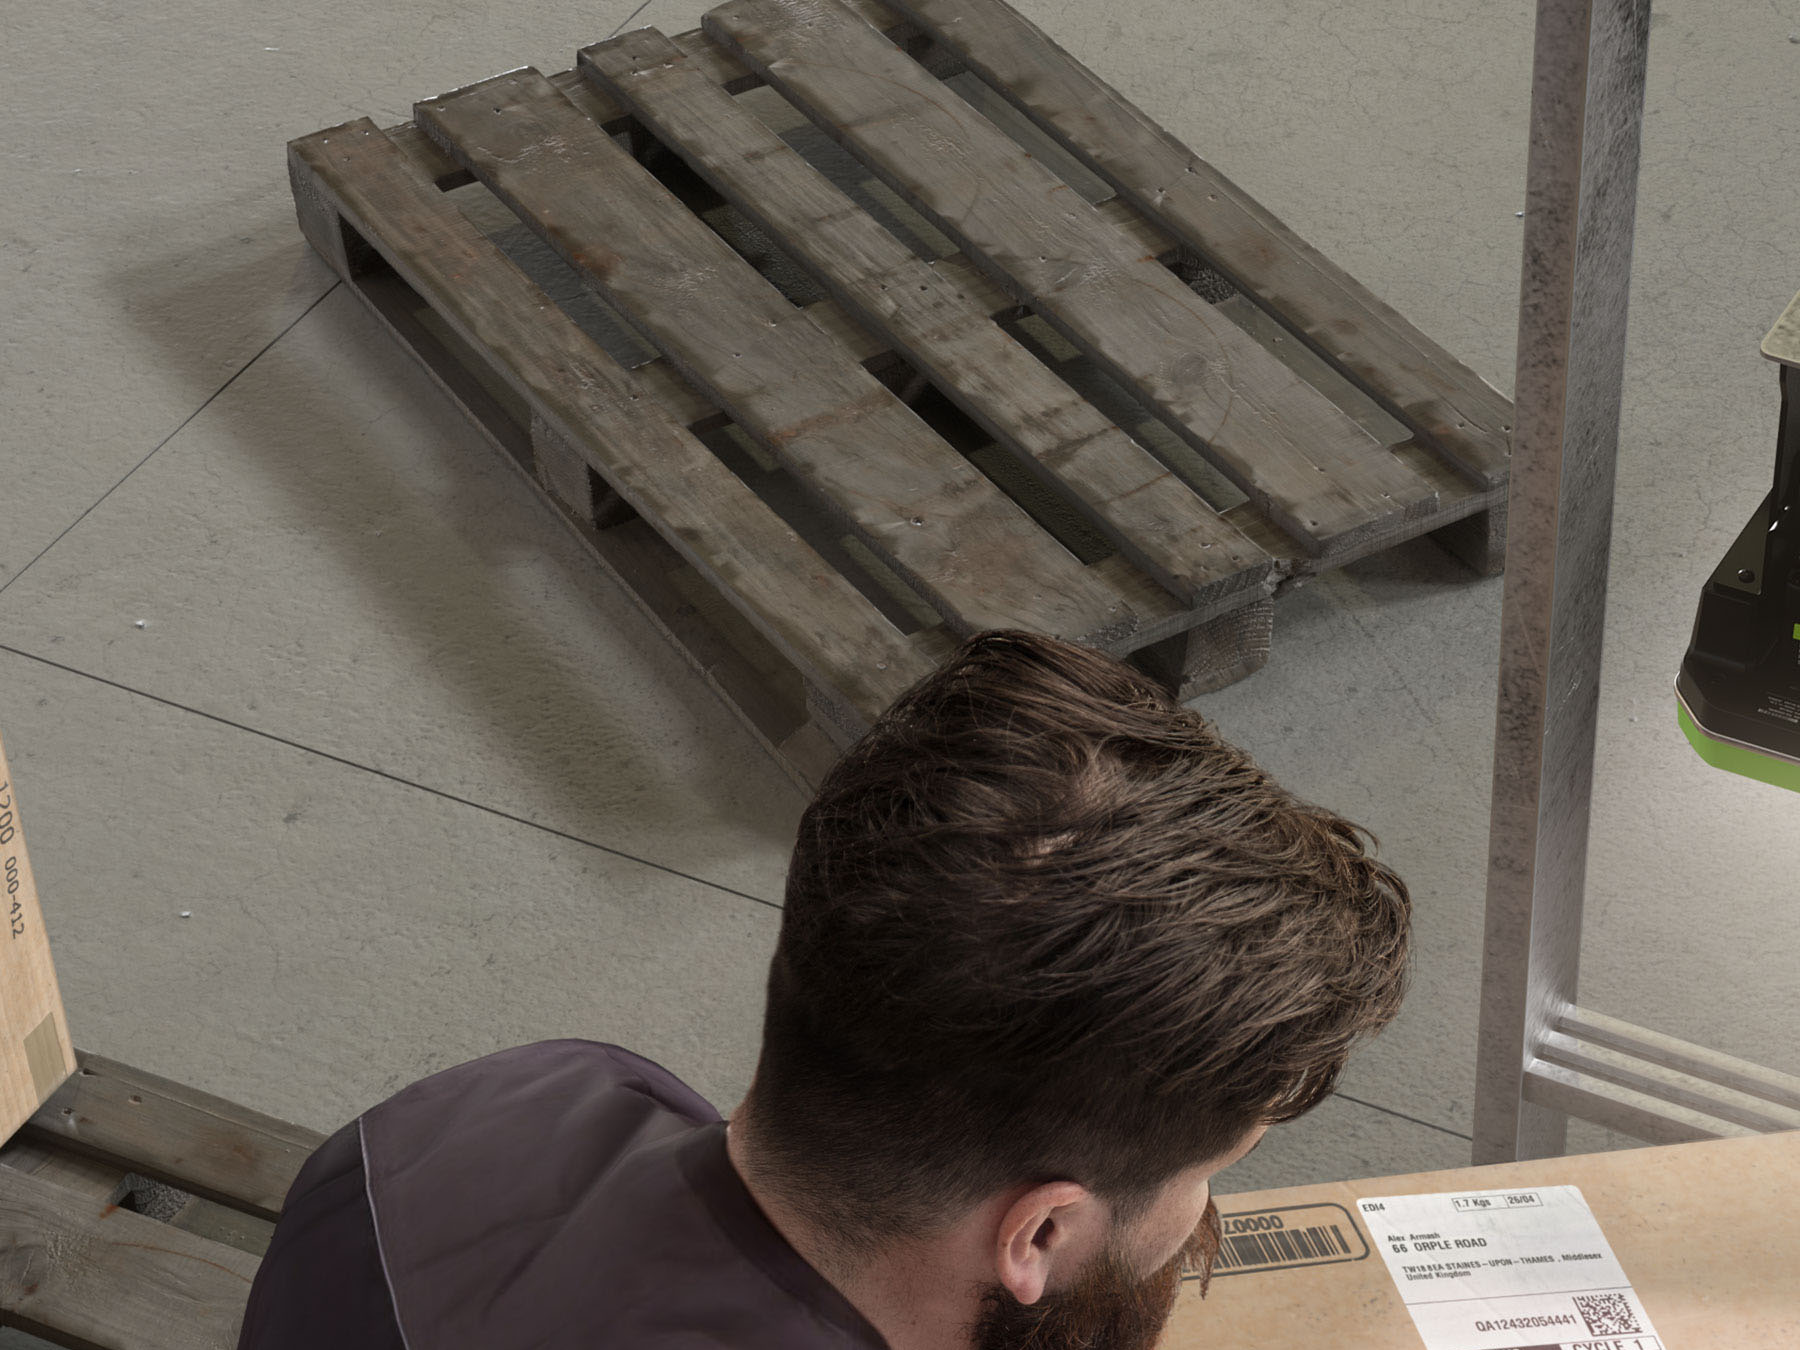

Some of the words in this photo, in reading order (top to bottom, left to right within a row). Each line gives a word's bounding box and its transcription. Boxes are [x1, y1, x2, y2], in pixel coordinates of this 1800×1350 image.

[5, 856, 25, 940] 000-412
[1455, 1198, 1470, 1209] 1.7
[1472, 1198, 1492, 1209] Kgs
[1508, 1194, 1536, 1205] 26/04
[1362, 1202, 1387, 1213] EDI4
[1387, 1234, 1406, 1243] Alex
[1392, 1243, 1409, 1254] 66
[1414, 1239, 1454, 1252] ORPLE
[1454, 1237, 1488, 1249] ROAD
[1445, 1260, 1482, 1271] STAINES
[1488, 1258, 1513, 1268] UPON
[1519, 1255, 1555, 1265] THAMES
[1405, 1271, 1434, 1281] United
[1434, 1269, 1472, 1280] Kingdom
[1475, 1313, 1577, 1332] QA12432054441
[1633, 1339, 1645, 1350] 1
